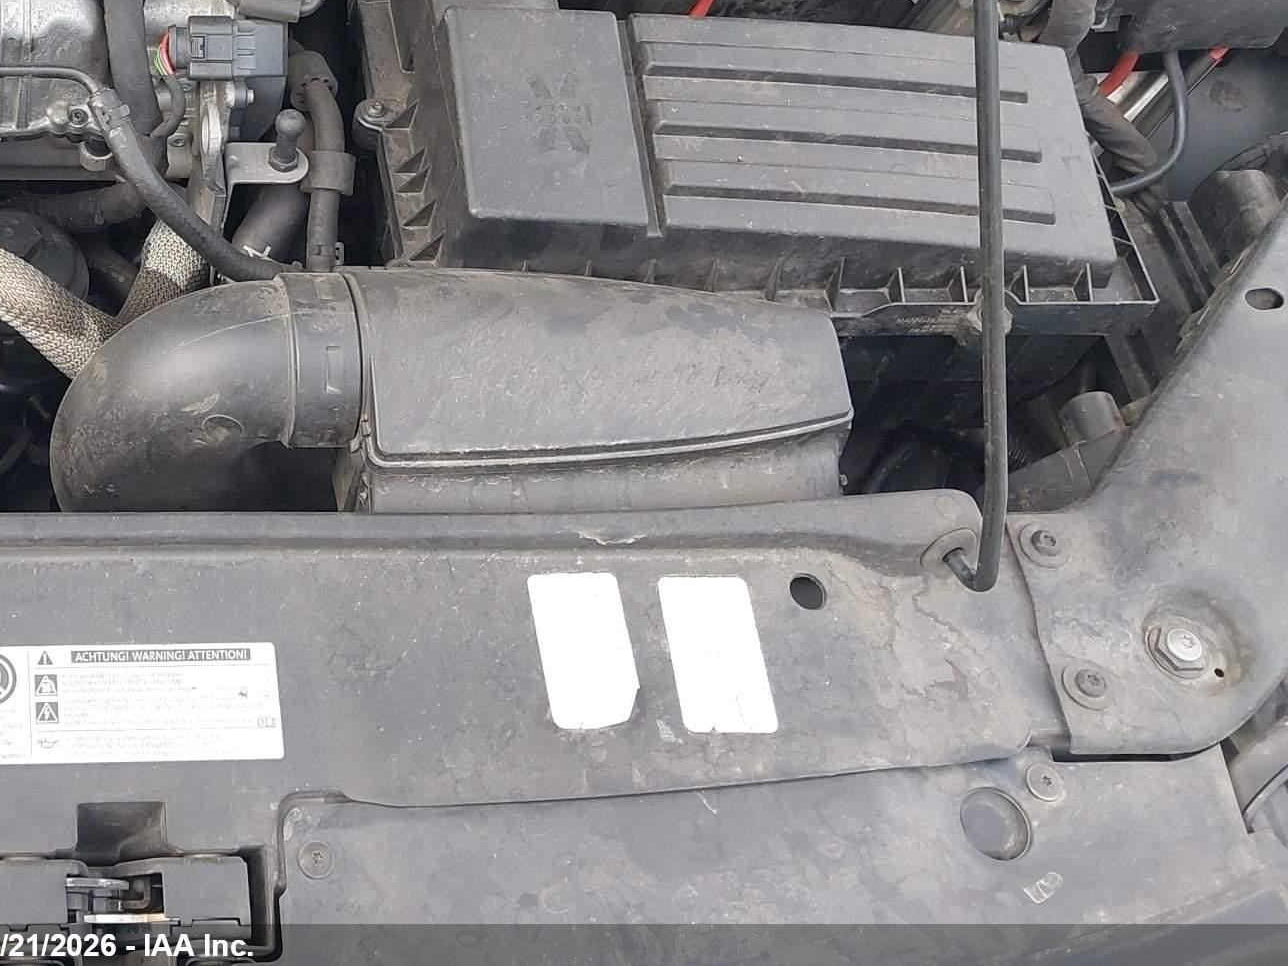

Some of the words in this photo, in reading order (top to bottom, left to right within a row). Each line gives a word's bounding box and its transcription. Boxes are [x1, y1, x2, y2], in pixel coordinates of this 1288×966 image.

[75, 651, 130, 662] ACHTUNG!
[131, 650, 185, 661] WARNING!
[187, 649, 248, 661] ATTENTION!
